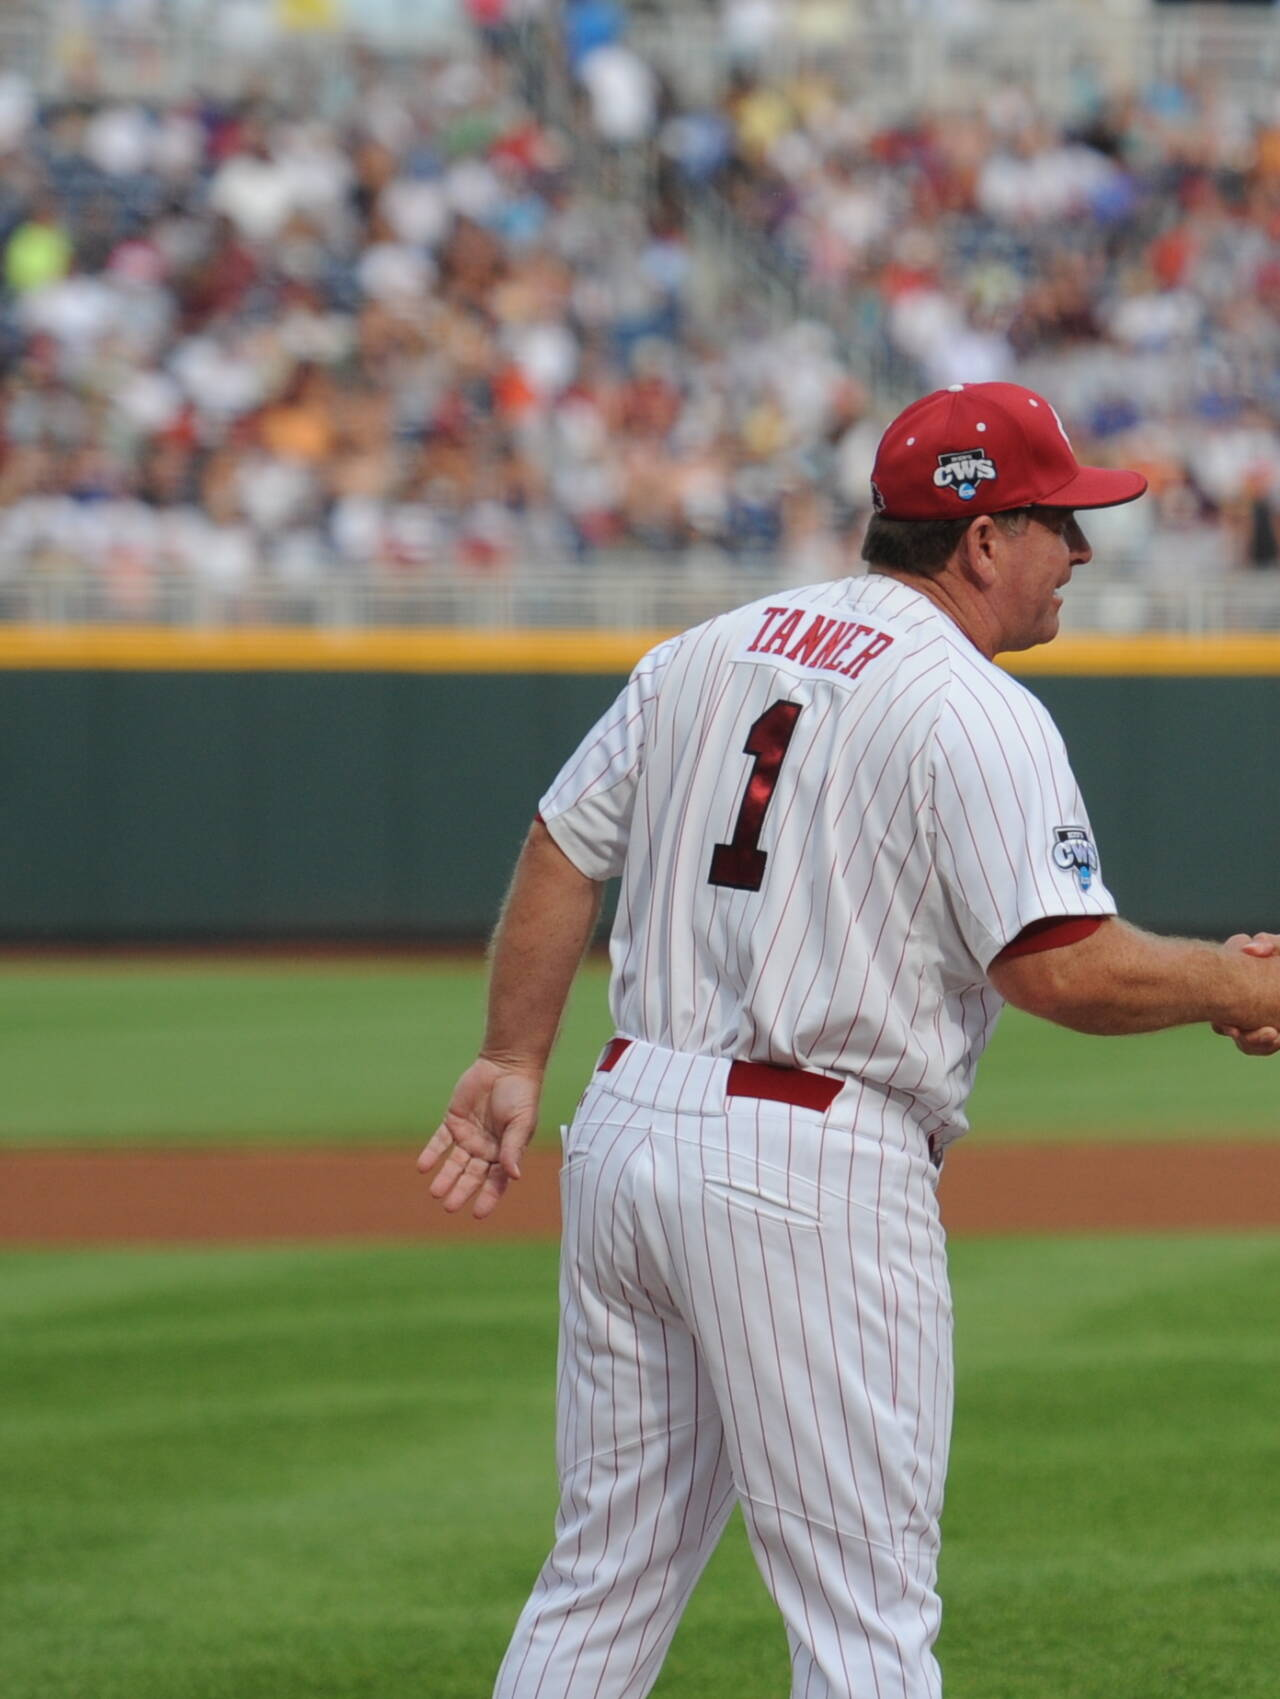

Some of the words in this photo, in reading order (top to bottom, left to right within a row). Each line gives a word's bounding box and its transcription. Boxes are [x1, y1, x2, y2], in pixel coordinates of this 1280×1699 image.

[933, 459, 996, 487] CWS
[747, 607, 894, 680] TANNER
[707, 699, 803, 892] 1
